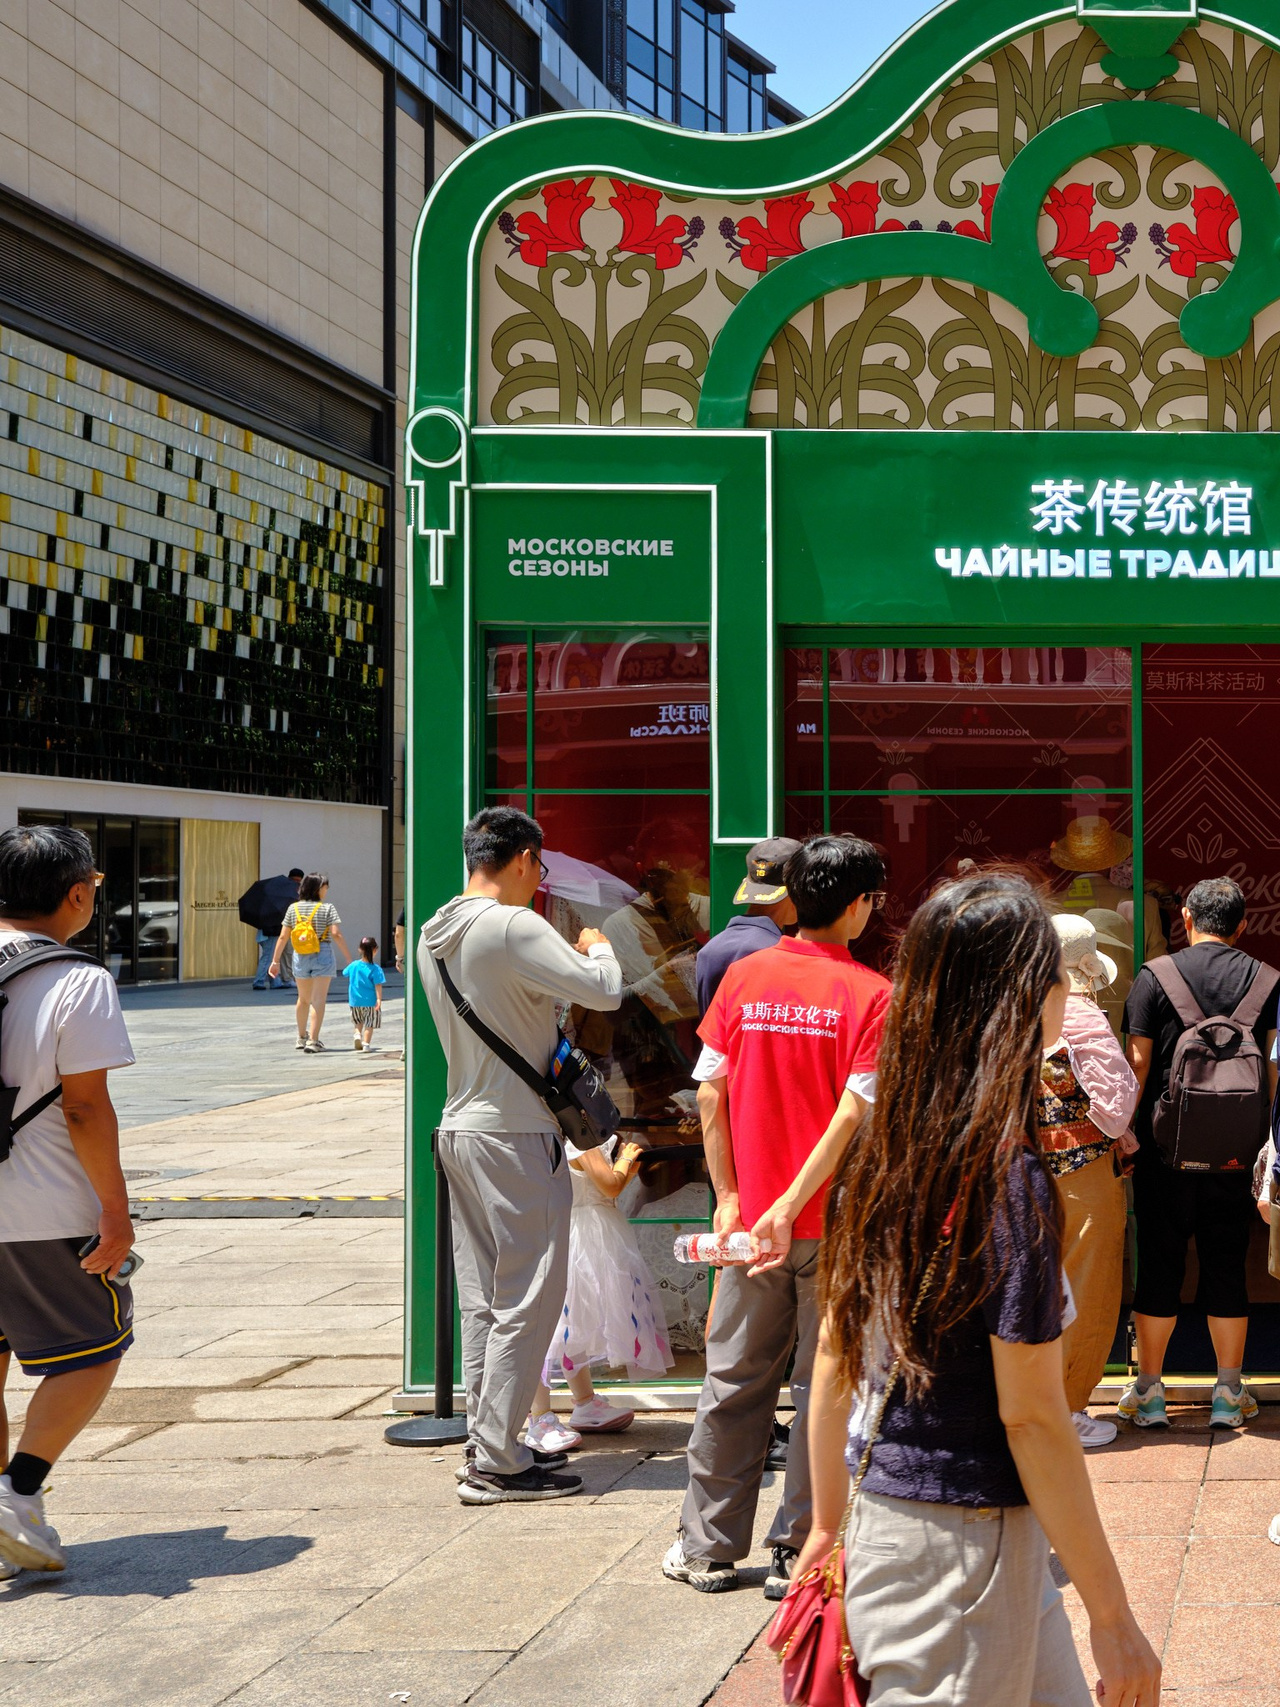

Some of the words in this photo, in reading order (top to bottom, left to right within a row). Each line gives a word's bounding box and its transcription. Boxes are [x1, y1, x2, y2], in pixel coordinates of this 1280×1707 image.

[1030, 479, 1253, 537] 茶传统馆
[508, 538, 674, 556] МОСКОВСКИЕ
[508, 559, 609, 577] СЕЗОНЫ
[934, 543, 1112, 578] ЧАЙНЫЕ
[1145, 671, 1265, 691] 莫斯科茶活动
[741, 1001, 842, 1027] 莫斯科文化节
[741, 1023, 799, 1034] МОСКОВСКИЕ
[799, 1027, 837, 1039] СЕЗОНЫ
